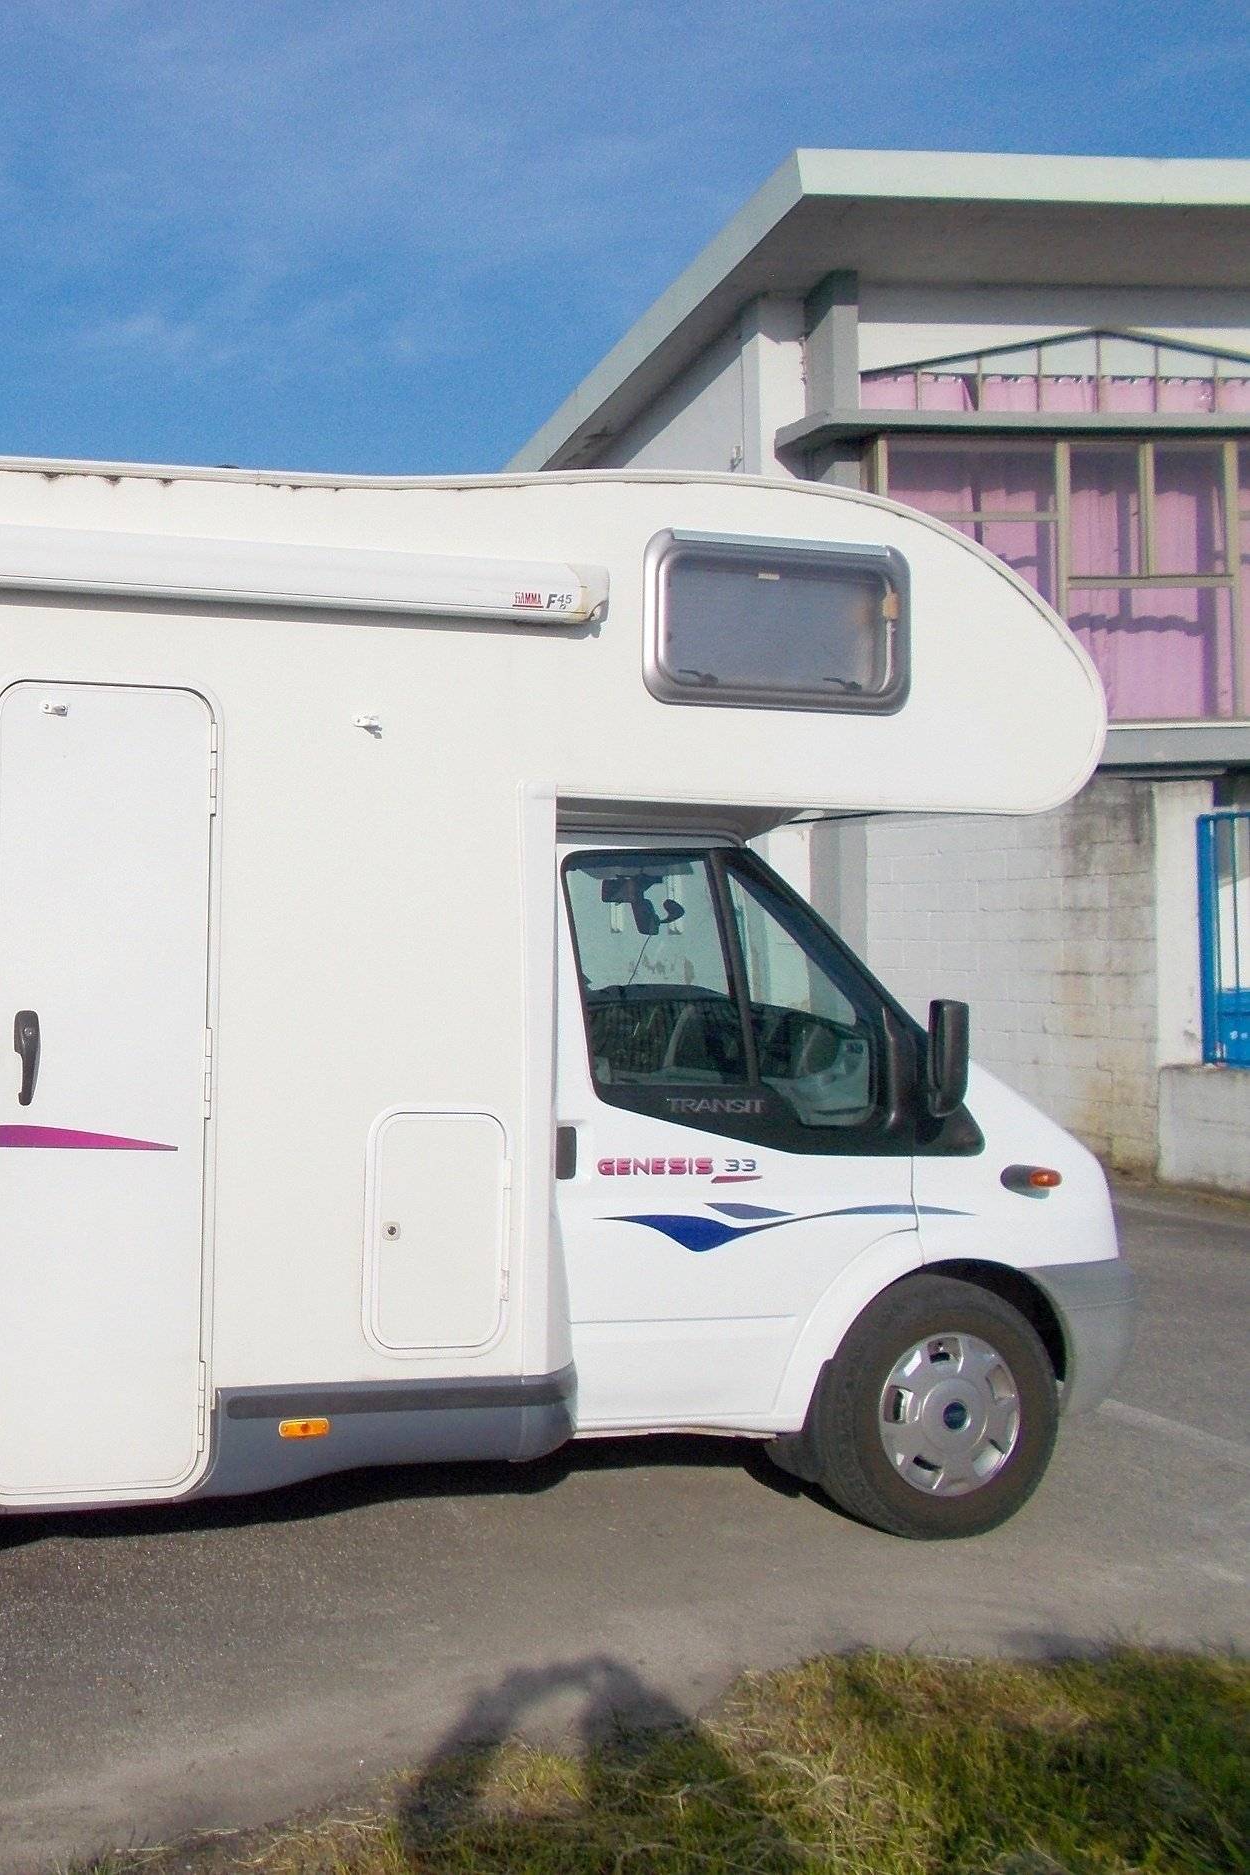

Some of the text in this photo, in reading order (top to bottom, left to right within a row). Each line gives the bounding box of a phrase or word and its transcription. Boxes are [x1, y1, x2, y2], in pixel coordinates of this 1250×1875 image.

[669, 1098, 765, 1114] TRANSIT
[597, 1157, 757, 1176] GENESIS 33
